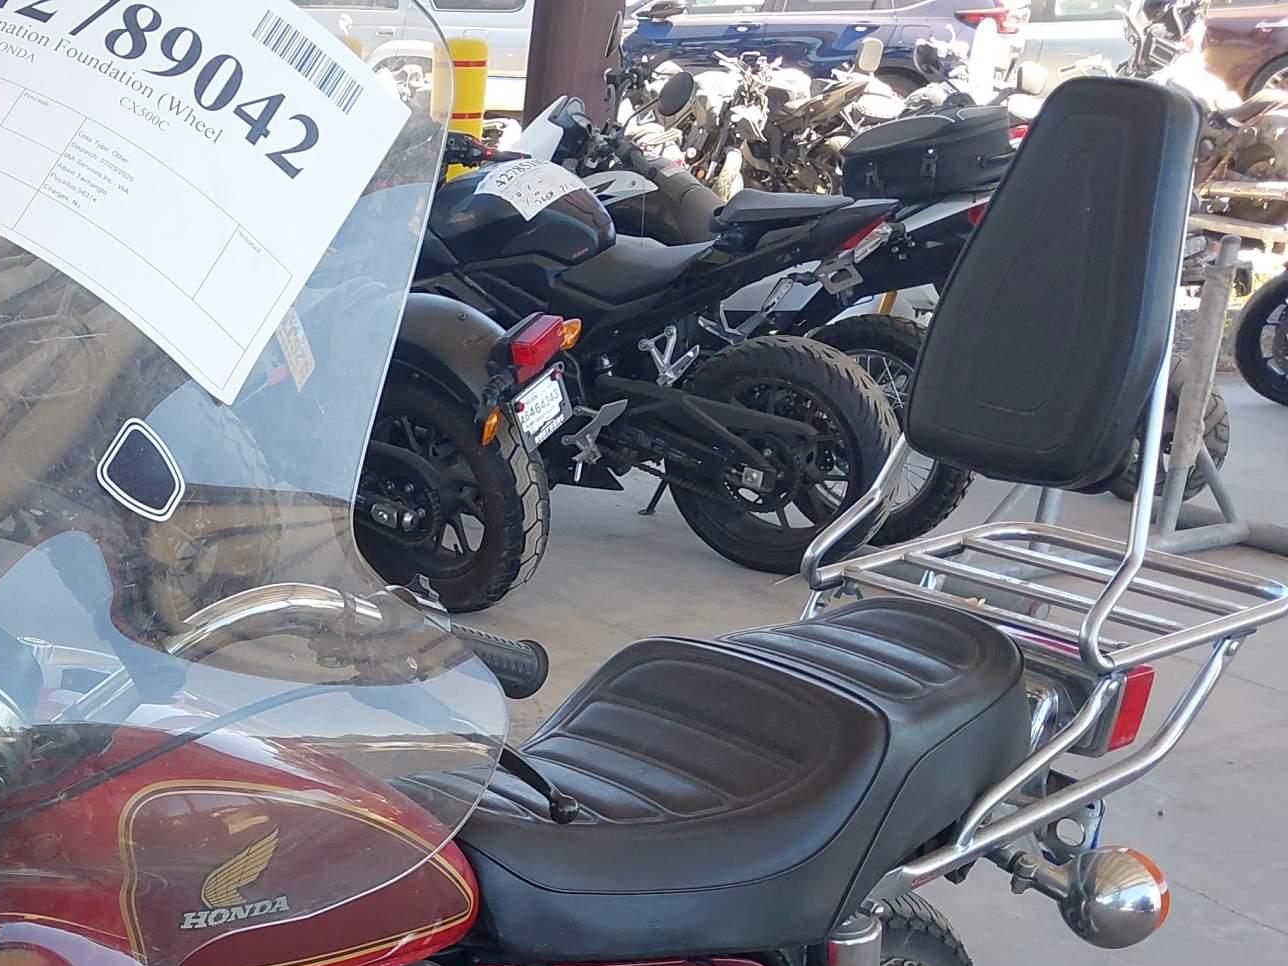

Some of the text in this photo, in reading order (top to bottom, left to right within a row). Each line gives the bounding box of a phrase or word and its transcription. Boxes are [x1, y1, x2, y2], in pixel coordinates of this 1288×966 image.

[54, 38, 154, 99] Foundation
[158, 93, 223, 144] (Wheel
[119, 96, 170, 132] CX500C
[180, 895, 290, 929] HONDA
